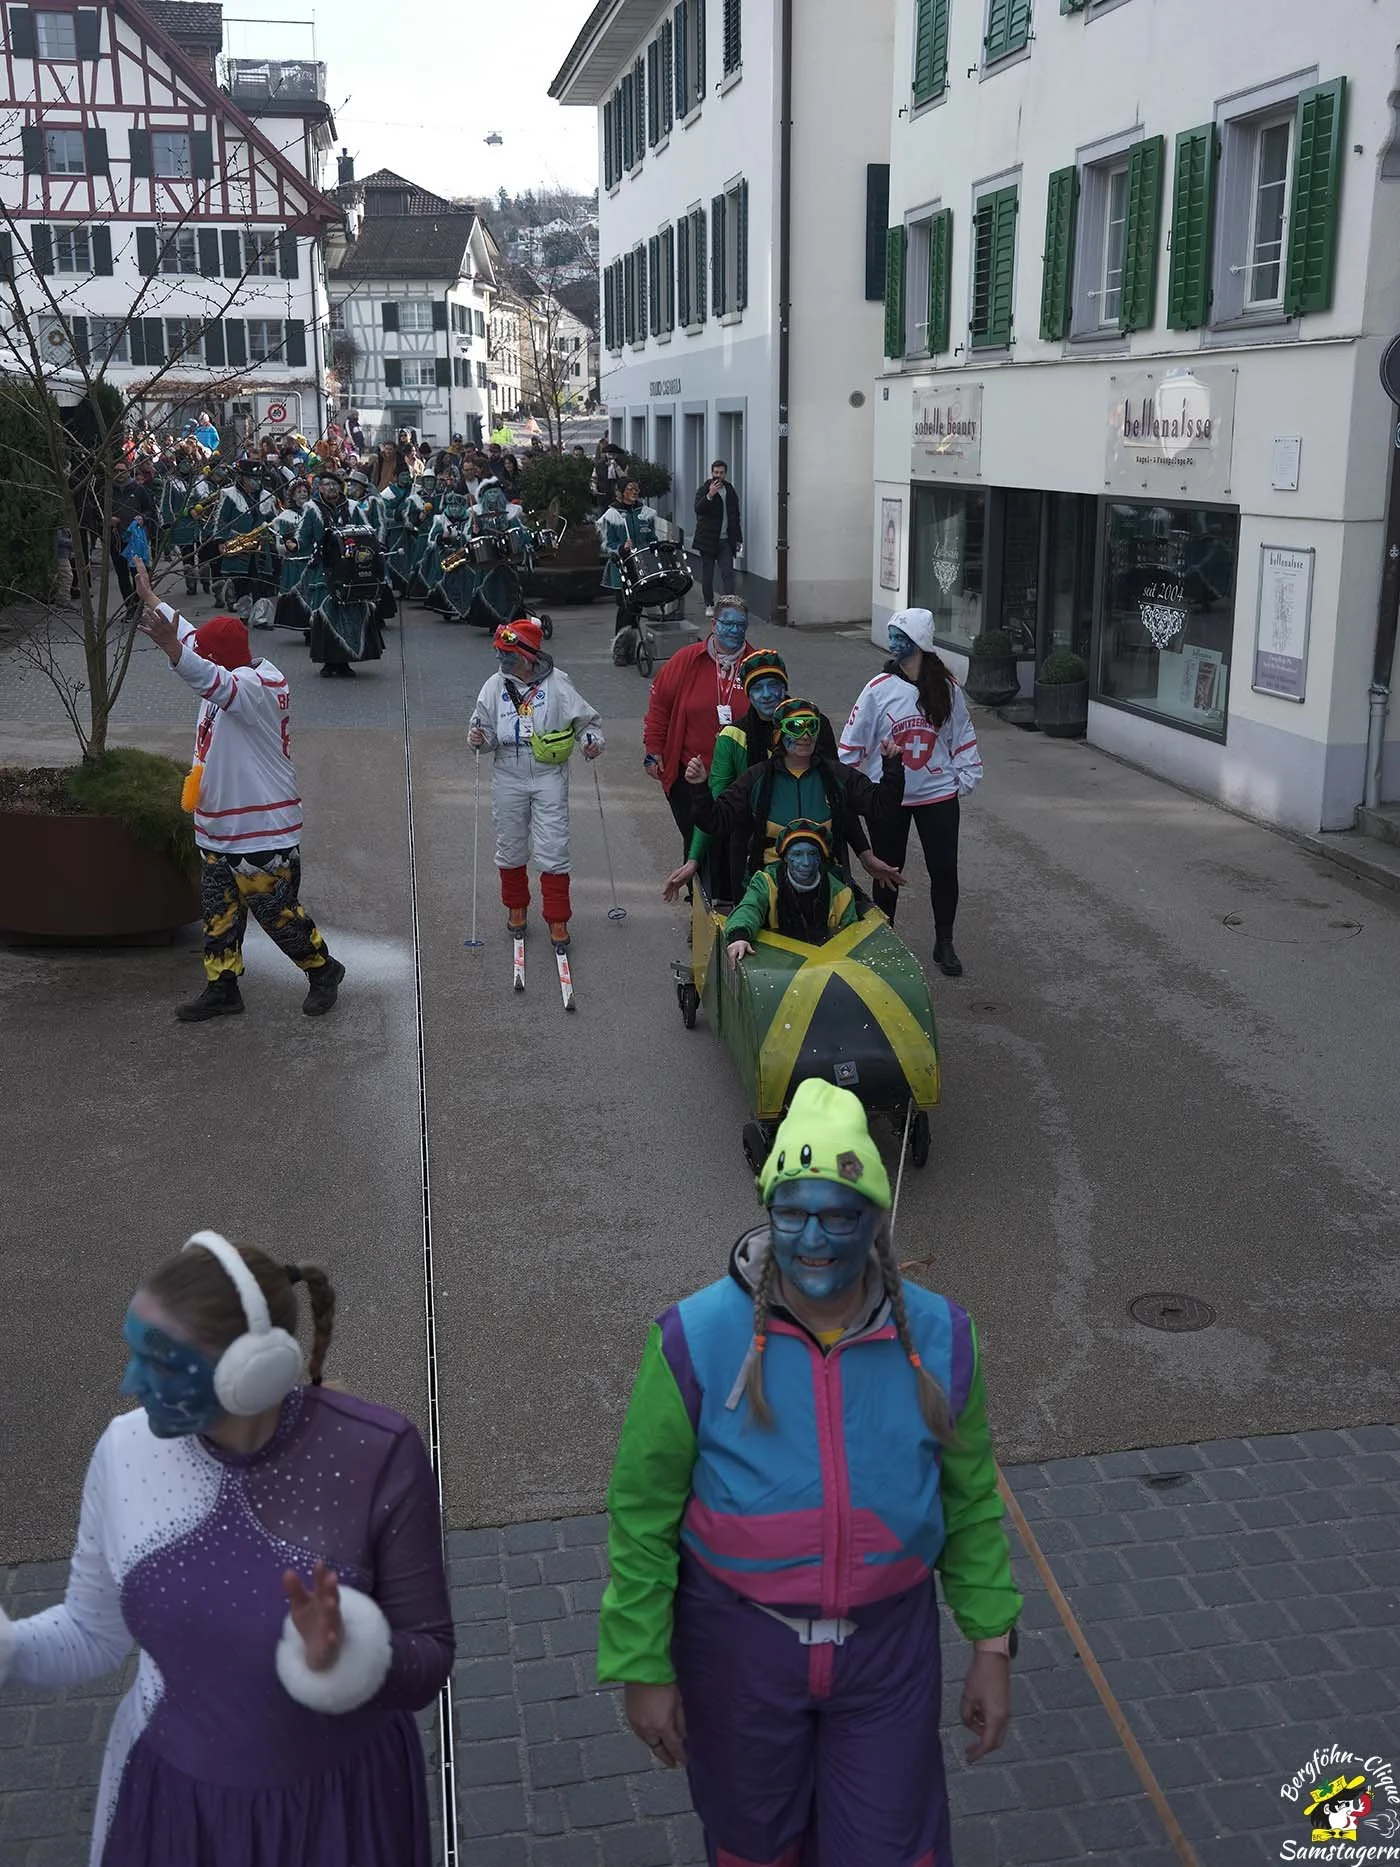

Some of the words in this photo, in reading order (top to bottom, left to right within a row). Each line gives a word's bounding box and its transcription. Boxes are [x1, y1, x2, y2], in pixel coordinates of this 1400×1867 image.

[915, 407, 944, 435] sobelle
[947, 407, 976, 440] beauty
[1123, 397, 1212, 437] bellenaisse
[1142, 582, 1157, 598] seit
[1157, 582, 1184, 602] 2004
